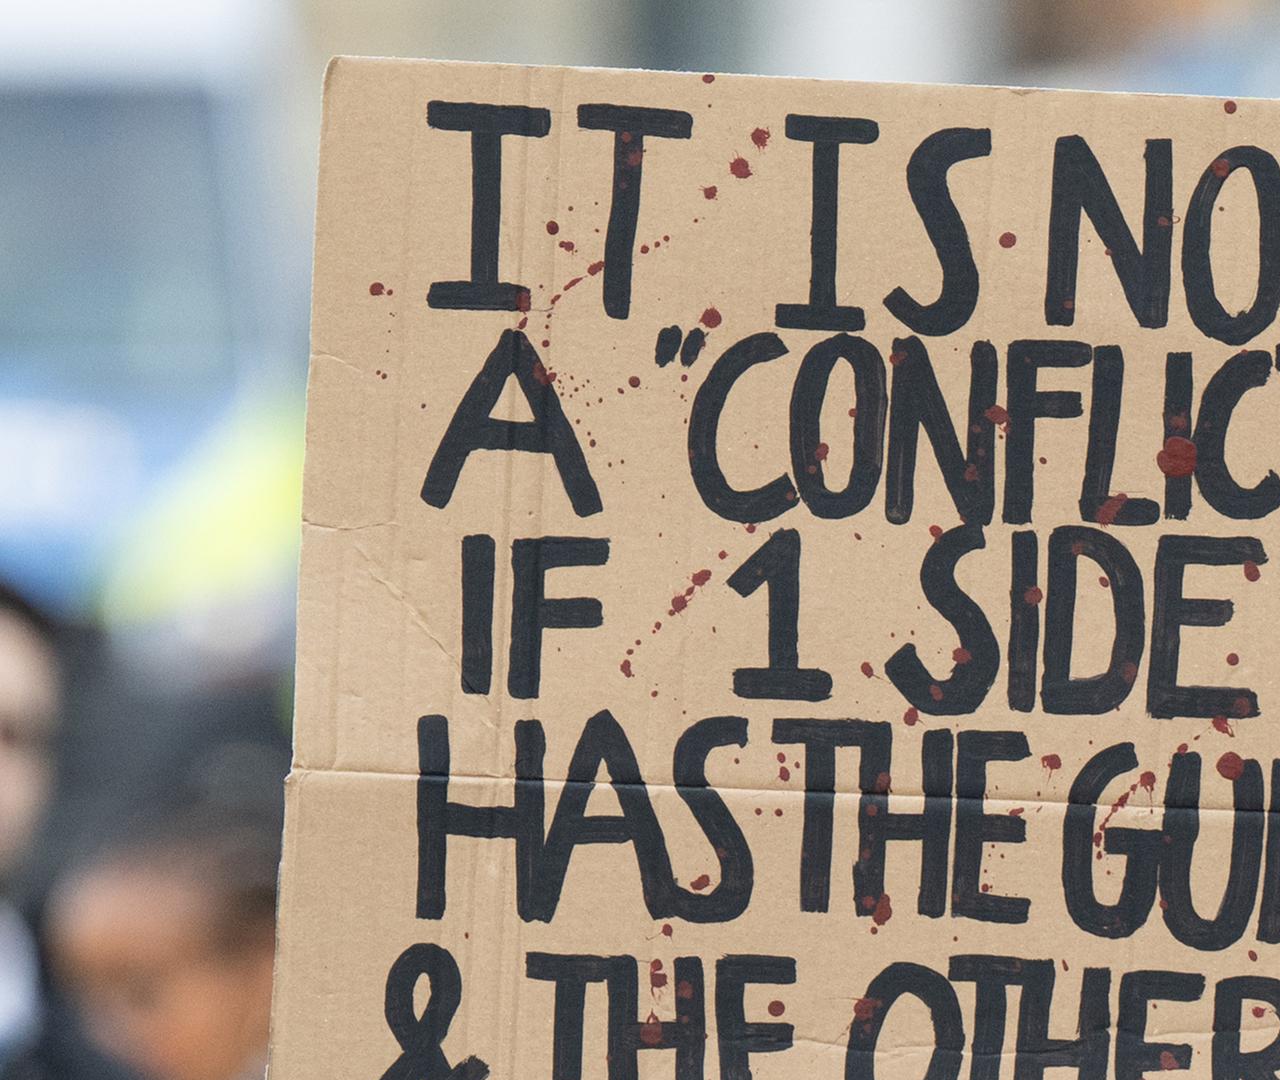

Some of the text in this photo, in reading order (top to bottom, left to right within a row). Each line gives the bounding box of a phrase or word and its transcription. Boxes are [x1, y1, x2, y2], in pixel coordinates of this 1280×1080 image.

[426, 100, 692, 319] IT
[774, 113, 992, 337] IS
[420, 329, 602, 517] A
[461, 523, 1268, 719] IF 1 SIDE
[415, 708, 754, 924] HAS
[771, 717, 1032, 924] THE
